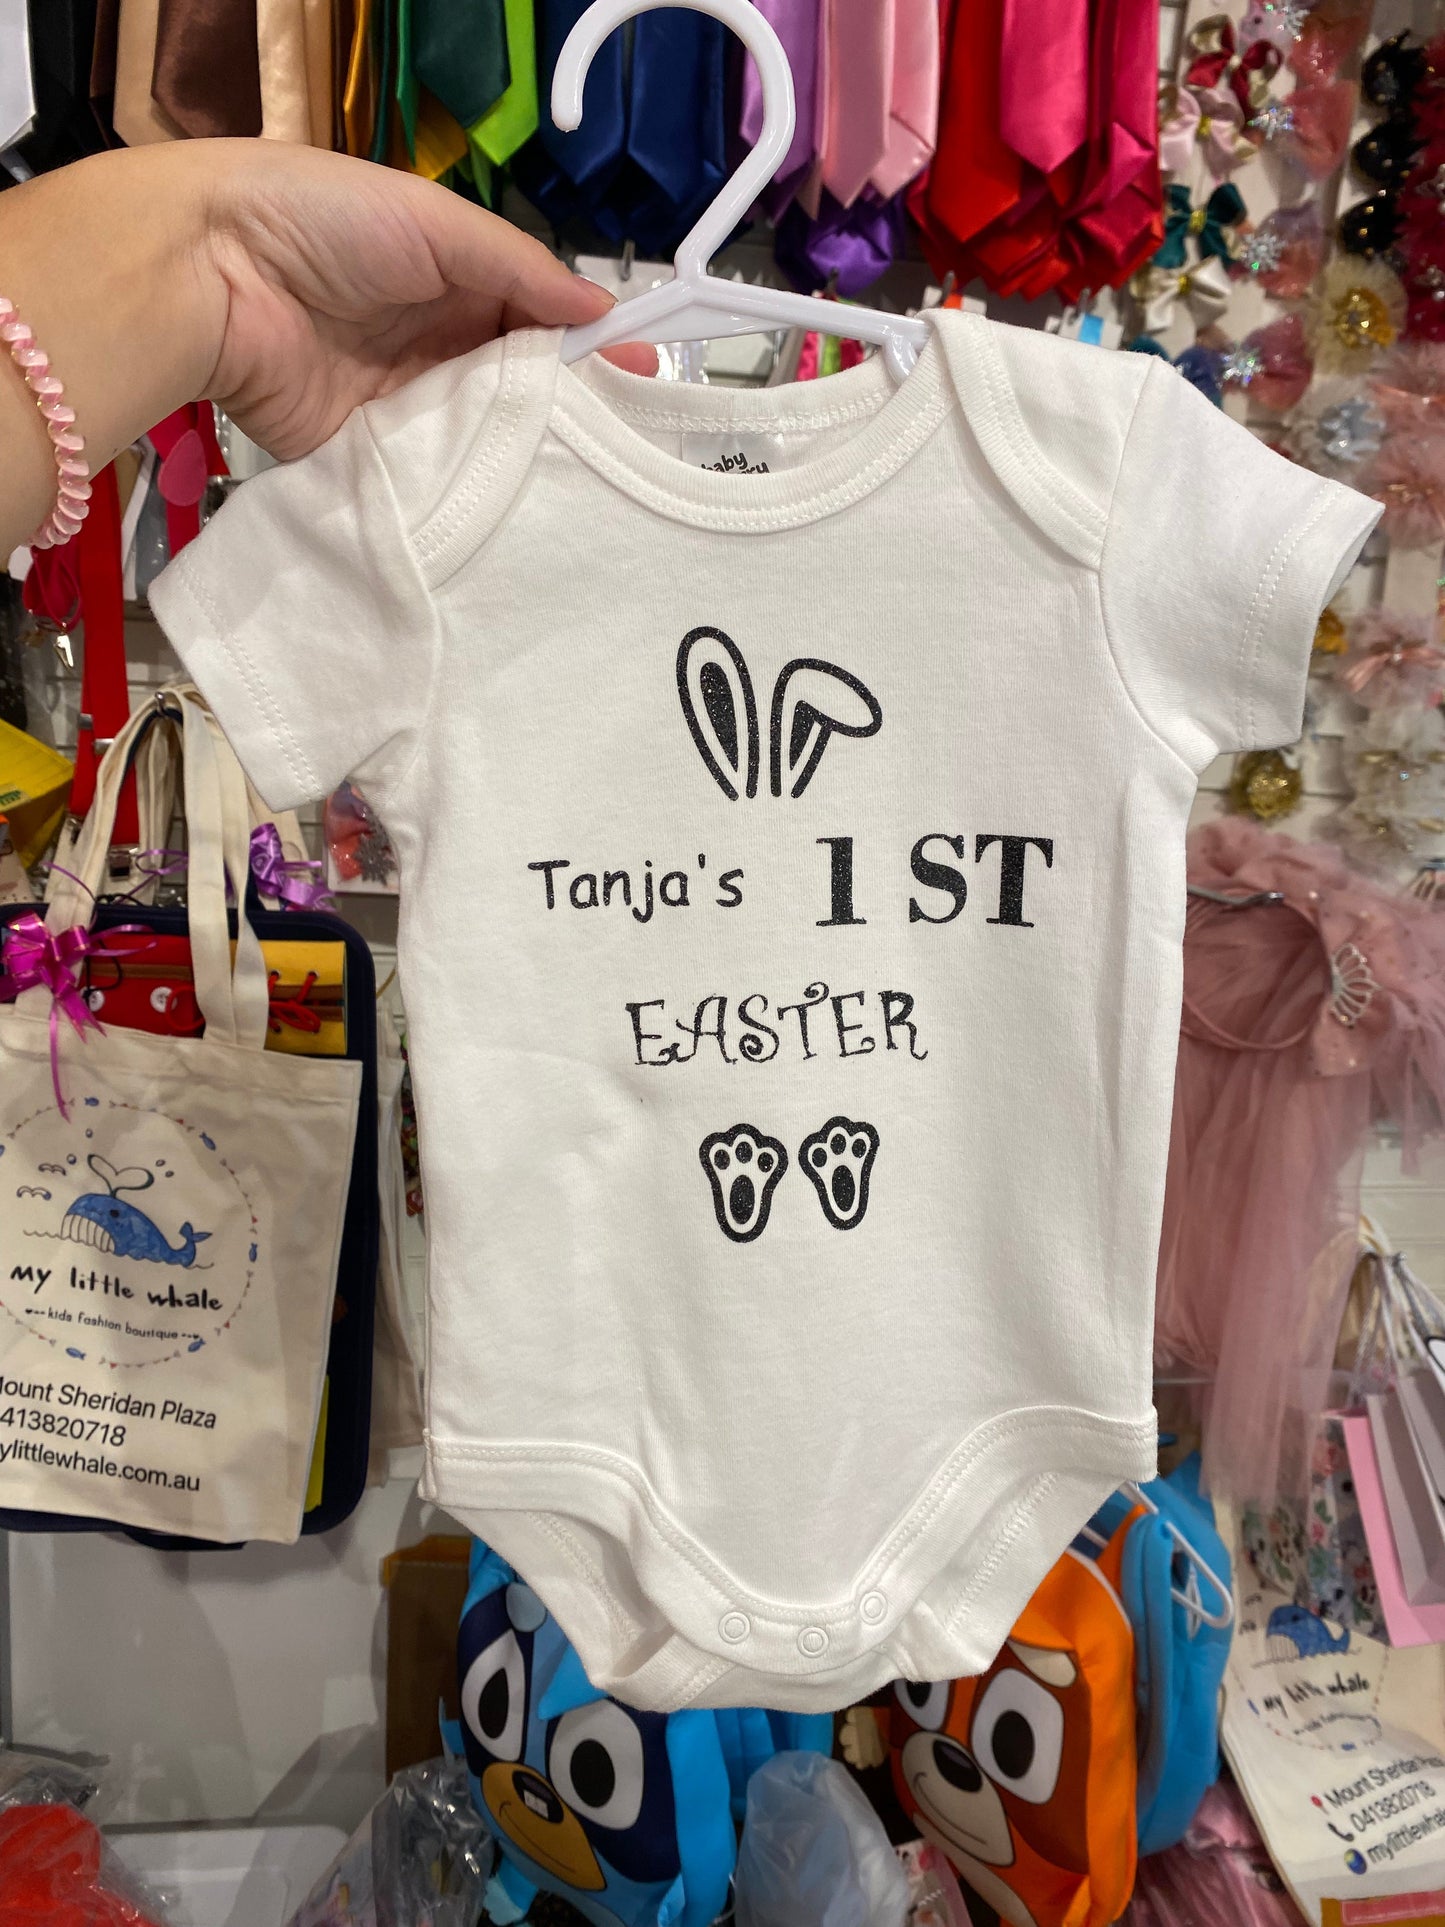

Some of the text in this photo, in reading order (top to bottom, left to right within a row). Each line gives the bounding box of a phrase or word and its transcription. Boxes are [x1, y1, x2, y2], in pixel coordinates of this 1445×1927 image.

[527, 853, 745, 923] Tanja's
[624, 981, 929, 1066] EASTER
[10, 1265, 223, 1311] my little whale
[48, 1306, 73, 1323] kids
[77, 1311, 122, 1332] fashion
[0, 1376, 217, 1430] ount Sheridan Plaza
[1325, 1776, 1376, 1809] Mount
